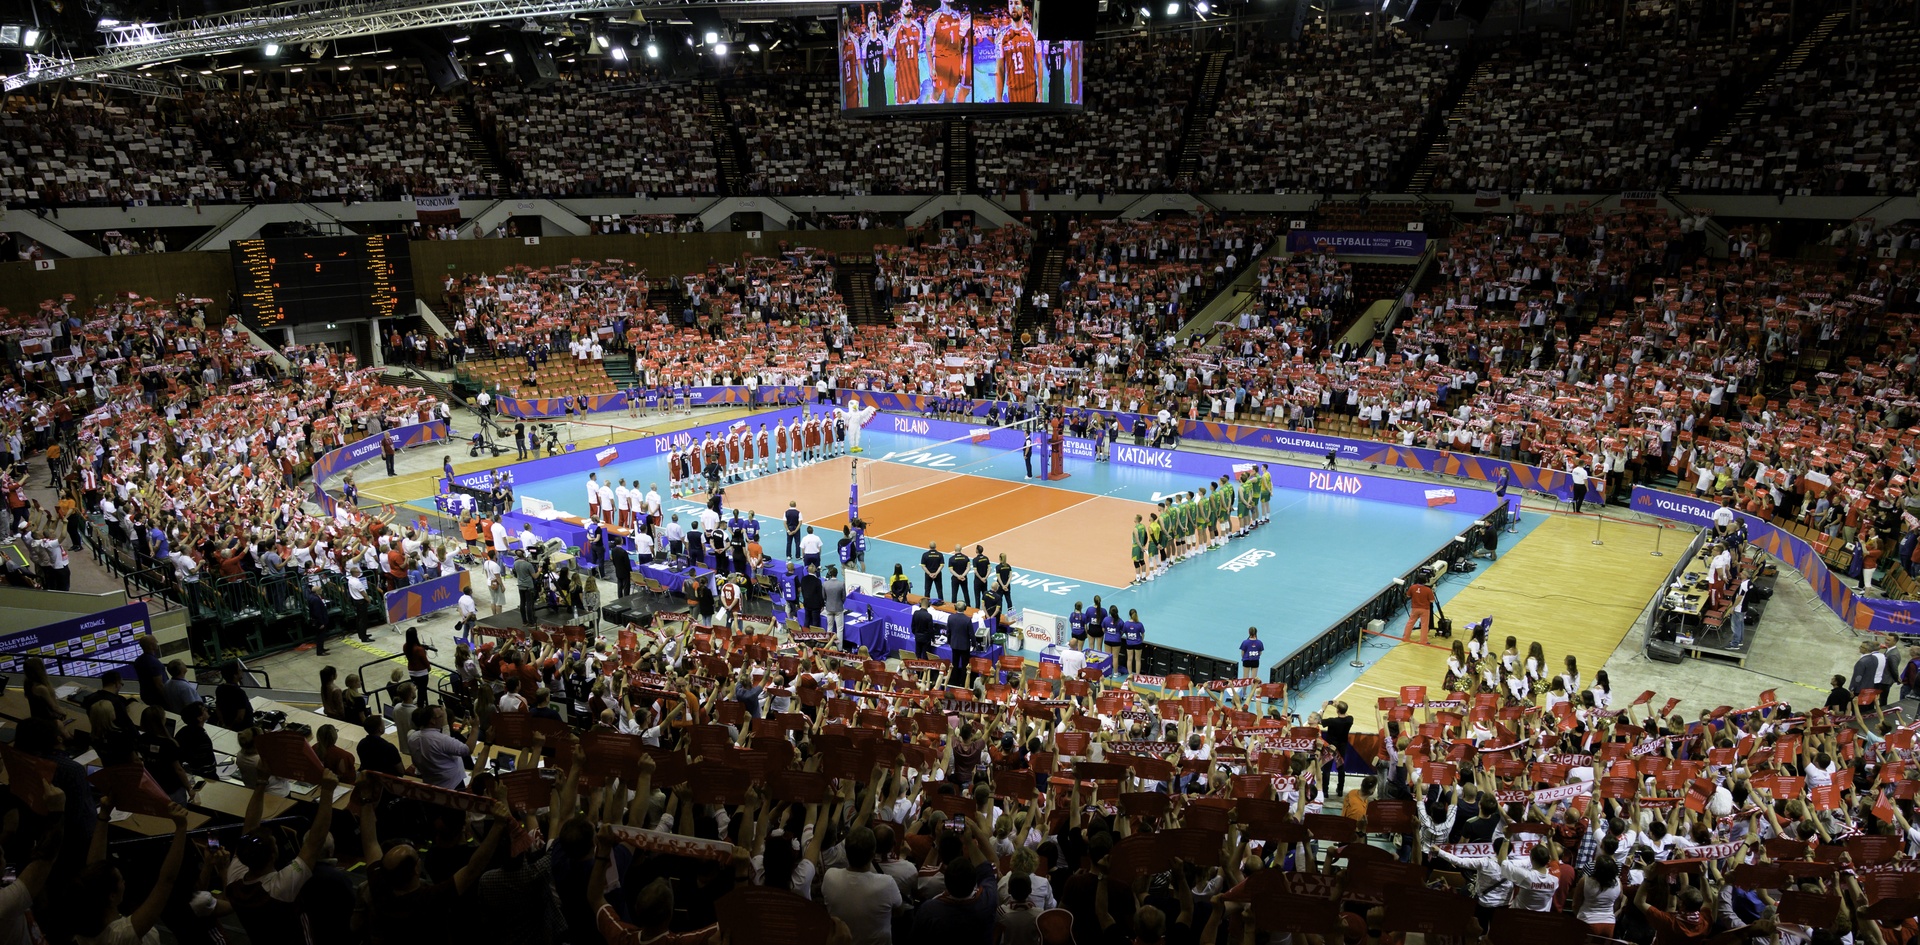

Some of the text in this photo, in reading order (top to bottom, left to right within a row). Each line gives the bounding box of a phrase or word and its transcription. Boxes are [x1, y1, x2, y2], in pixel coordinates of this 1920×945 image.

[1012, 52, 1024, 70] 13
[1313, 236, 1371, 246] VOLLEYBALL
[1882, 249, 1890, 257] K
[316, 264, 321, 272] 2
[895, 417, 930, 435] POLAND
[656, 432, 692, 454] POLAND
[1063, 441, 1092, 450] LEYBALL
[1276, 436, 1324, 450] VOLLEYBALL
[1344, 445, 1358, 453] FIVB
[1118, 446, 1172, 468] KATOWICE
[1309, 472, 1362, 494] POLAND
[1638, 494, 1653, 507] VNL
[1656, 499, 1715, 522] VOLLEYBALL
[432, 586, 452, 604] VNL
[1888, 610, 1917, 626] VNL
[885, 622, 910, 635] EYBALL
[19, 638, 39, 649] LEAGUE
[617, 829, 718, 856] POLSKA
